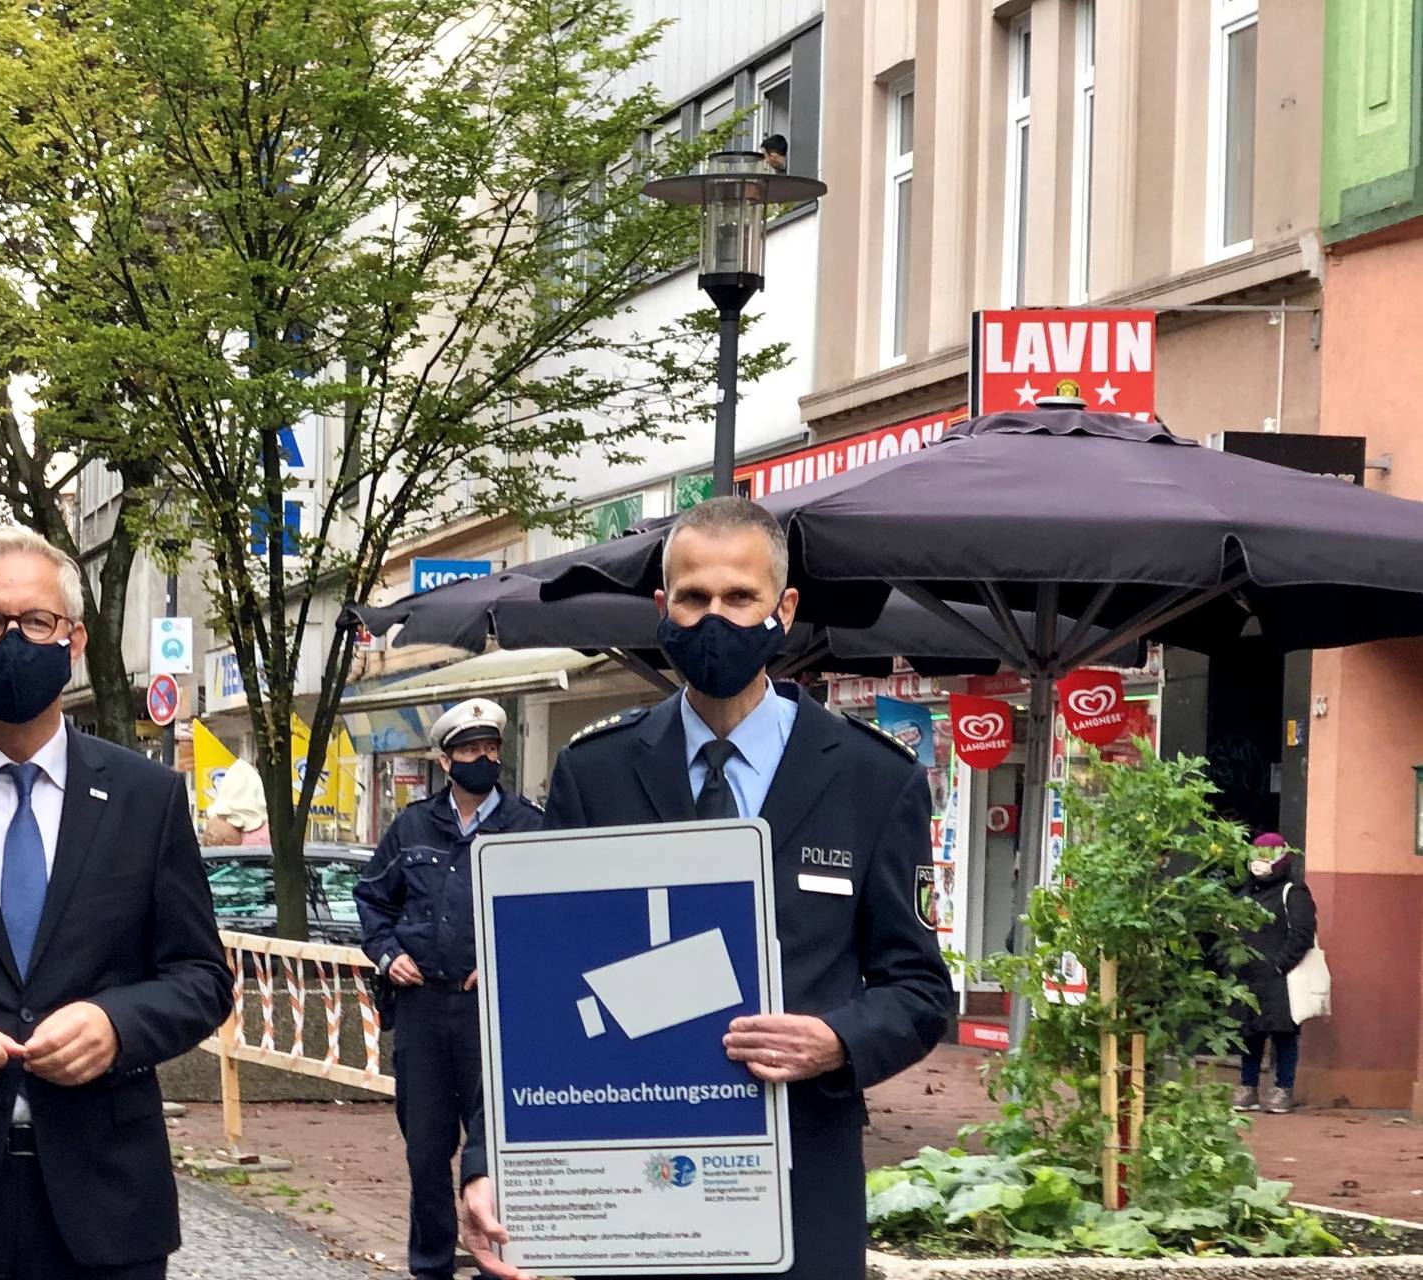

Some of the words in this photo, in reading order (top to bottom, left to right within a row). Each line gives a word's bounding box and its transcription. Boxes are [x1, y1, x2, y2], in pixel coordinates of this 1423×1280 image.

[986, 321, 1152, 373] LAVIN
[1073, 712, 1122, 731] LANGNESE
[961, 739, 1008, 753] LANGNESE
[801, 846, 853, 868] POLIZEI
[512, 1080, 759, 1107] Videobeobachtungszone
[566, 1166, 605, 1175] Dortmund
[702, 1155, 760, 1168] POLIZEI
